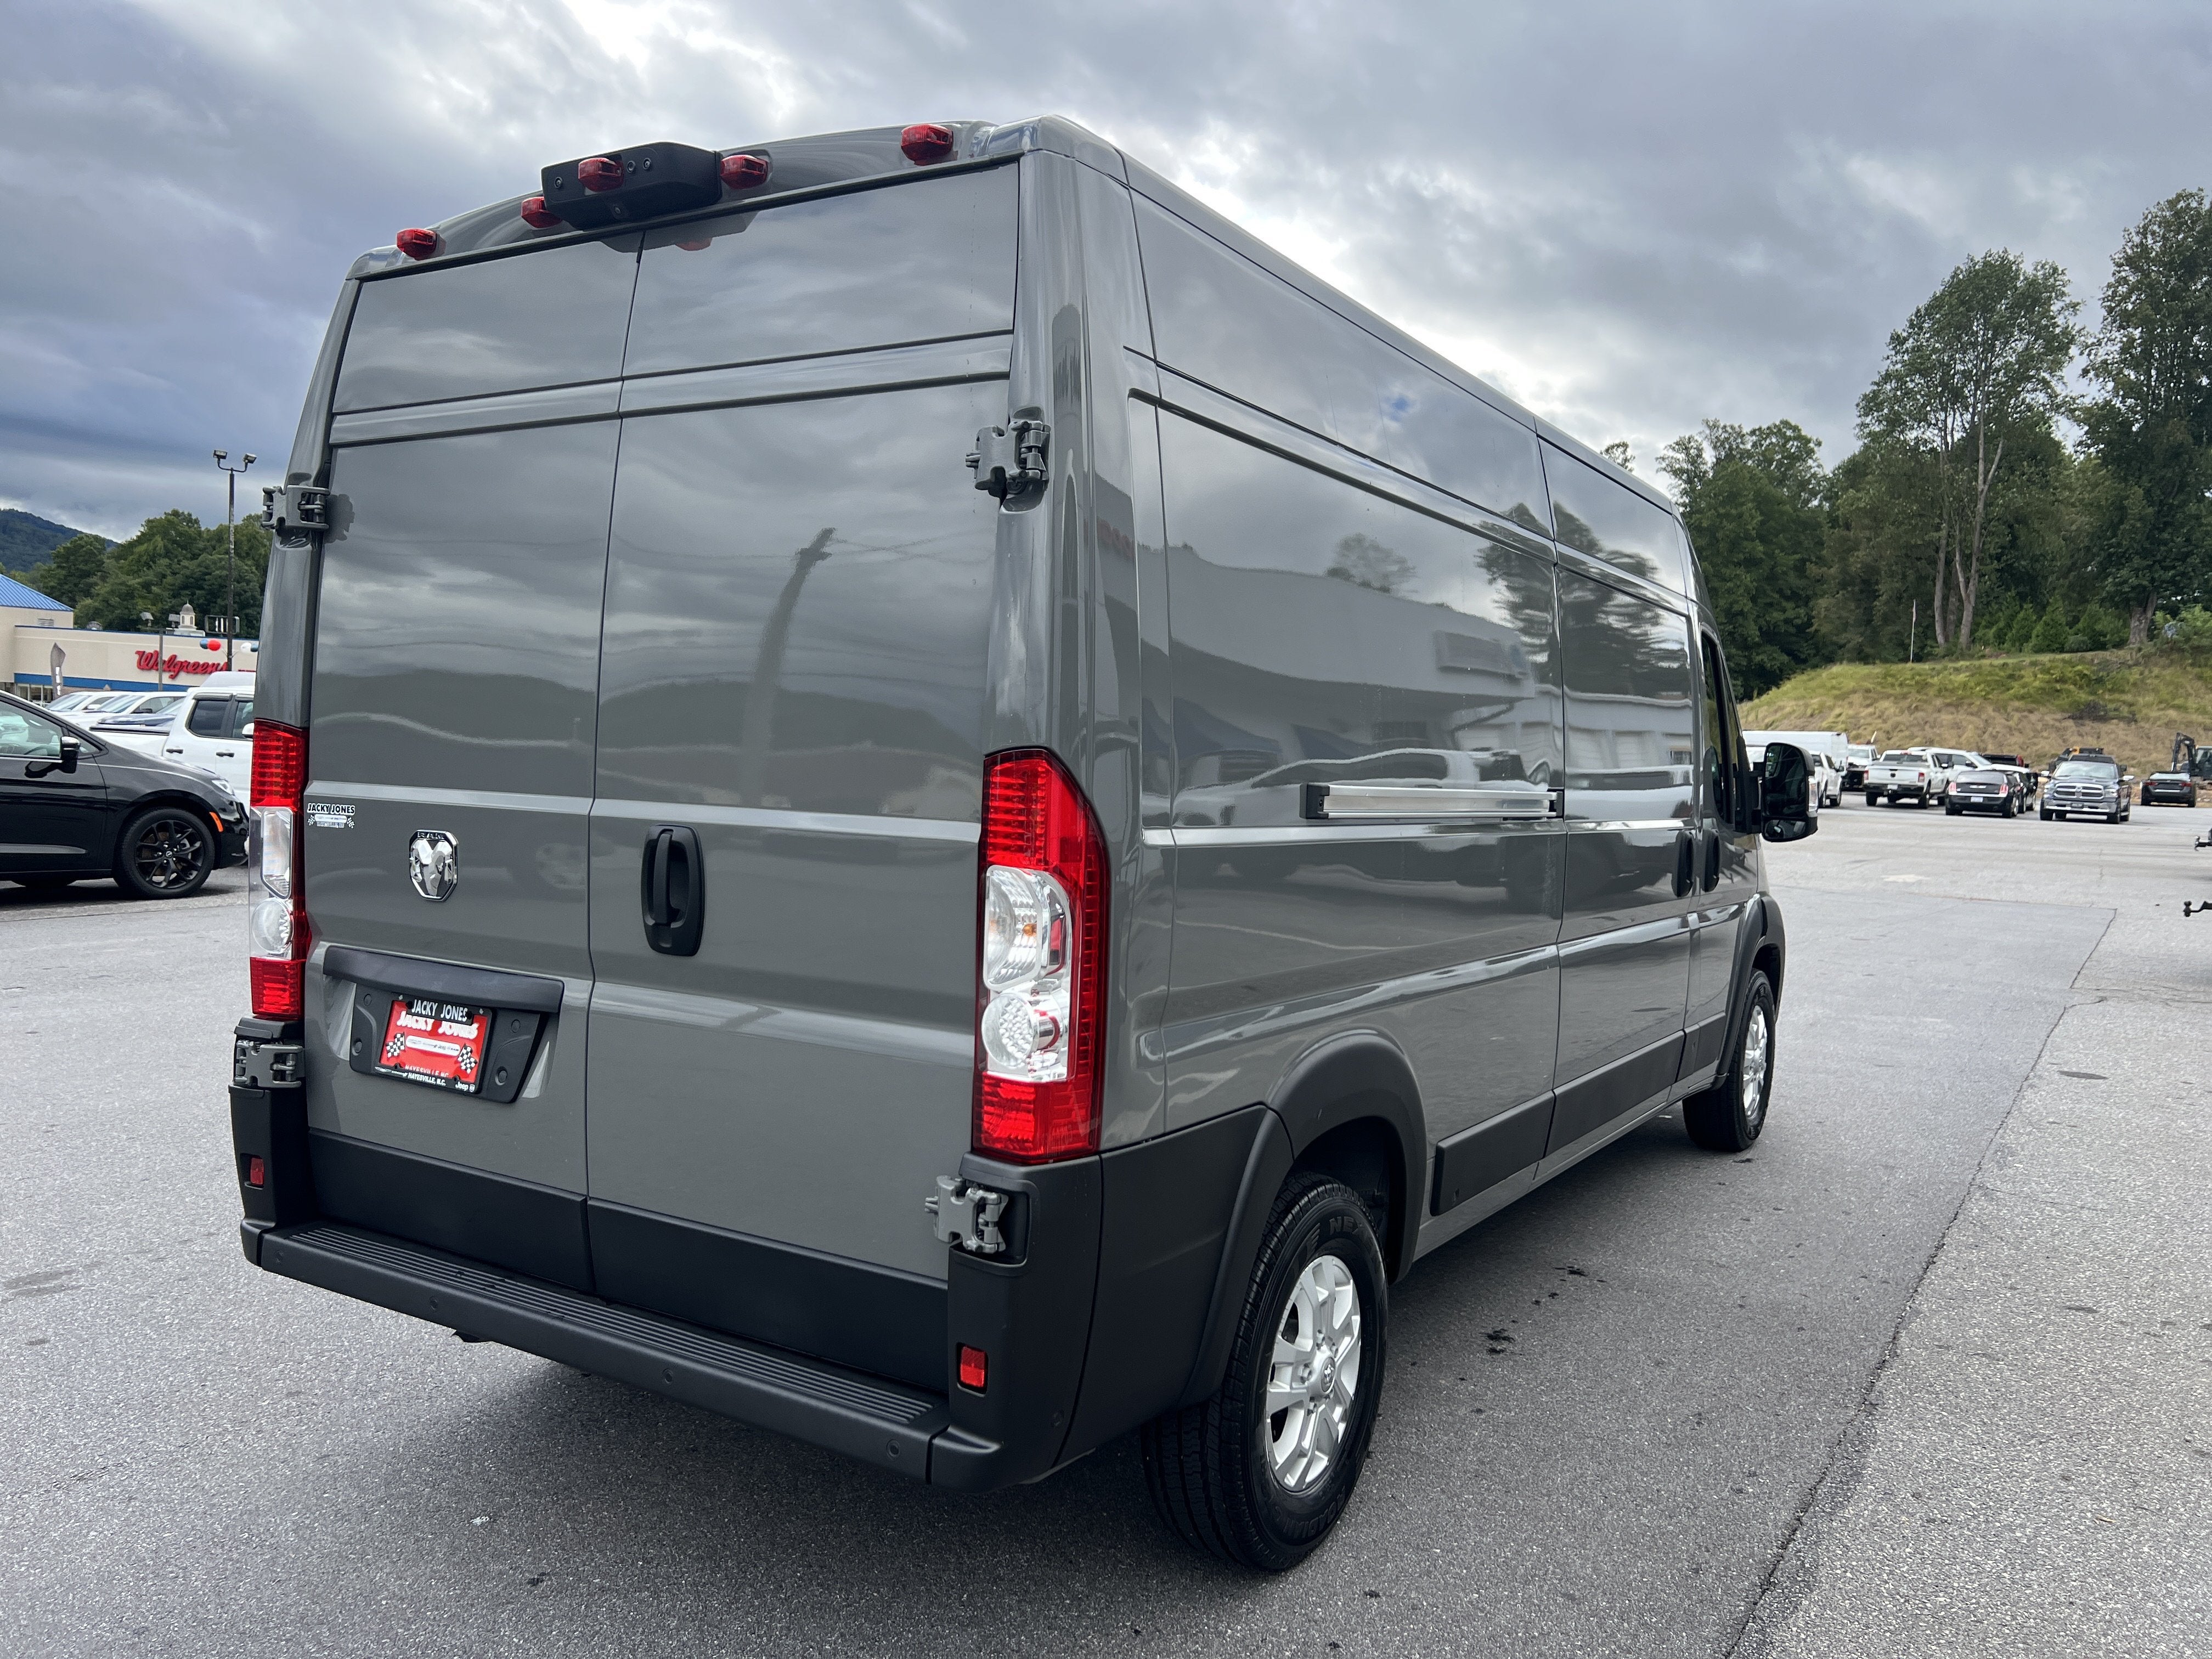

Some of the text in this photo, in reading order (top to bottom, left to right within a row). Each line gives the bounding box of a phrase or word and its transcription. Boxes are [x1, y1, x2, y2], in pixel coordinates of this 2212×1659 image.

[308, 804, 355, 814] JACKY JONES
[411, 999, 468, 1022] JACKY JONES
[397, 1011, 479, 1040] JACKY JONES
[455, 1081, 469, 1091] Jeep
